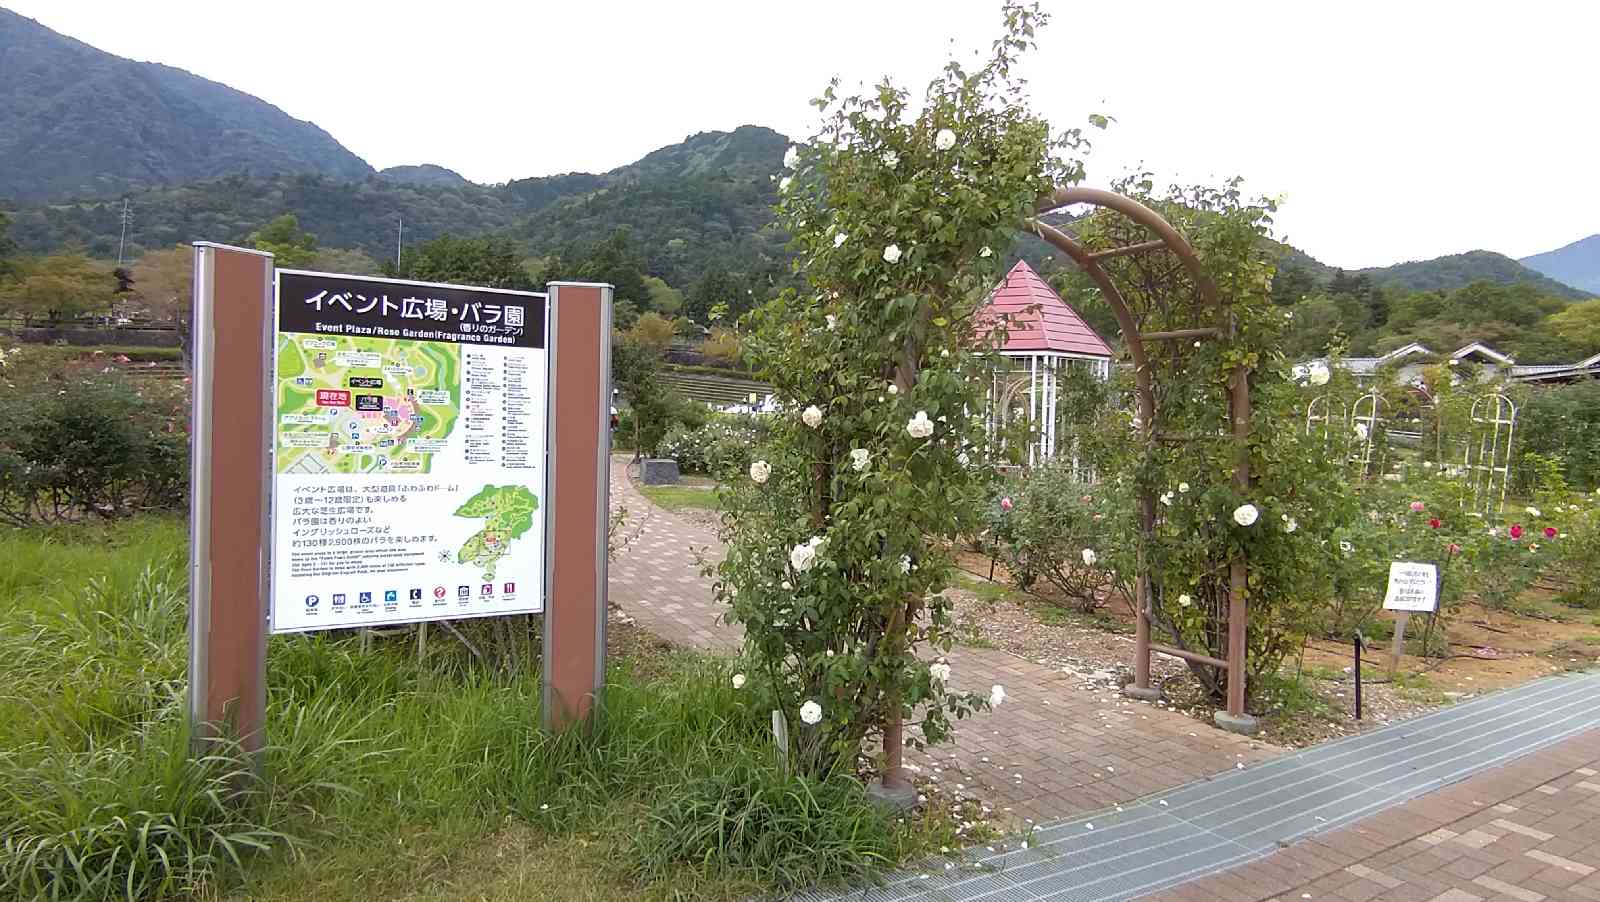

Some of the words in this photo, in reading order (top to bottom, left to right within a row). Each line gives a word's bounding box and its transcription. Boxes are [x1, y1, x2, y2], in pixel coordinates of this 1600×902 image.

[305, 290, 525, 327] イベント広場・バラ園
[315, 322, 343, 333] Event
[345, 323, 400, 336] Plaza/Rose
[460, 322, 524, 337] (香りのガーデン)
[320, 391, 347, 401] 現在地
[292, 516, 372, 526] バラ園は香りのよい
[292, 525, 391, 537] イングリッシュローズなど
